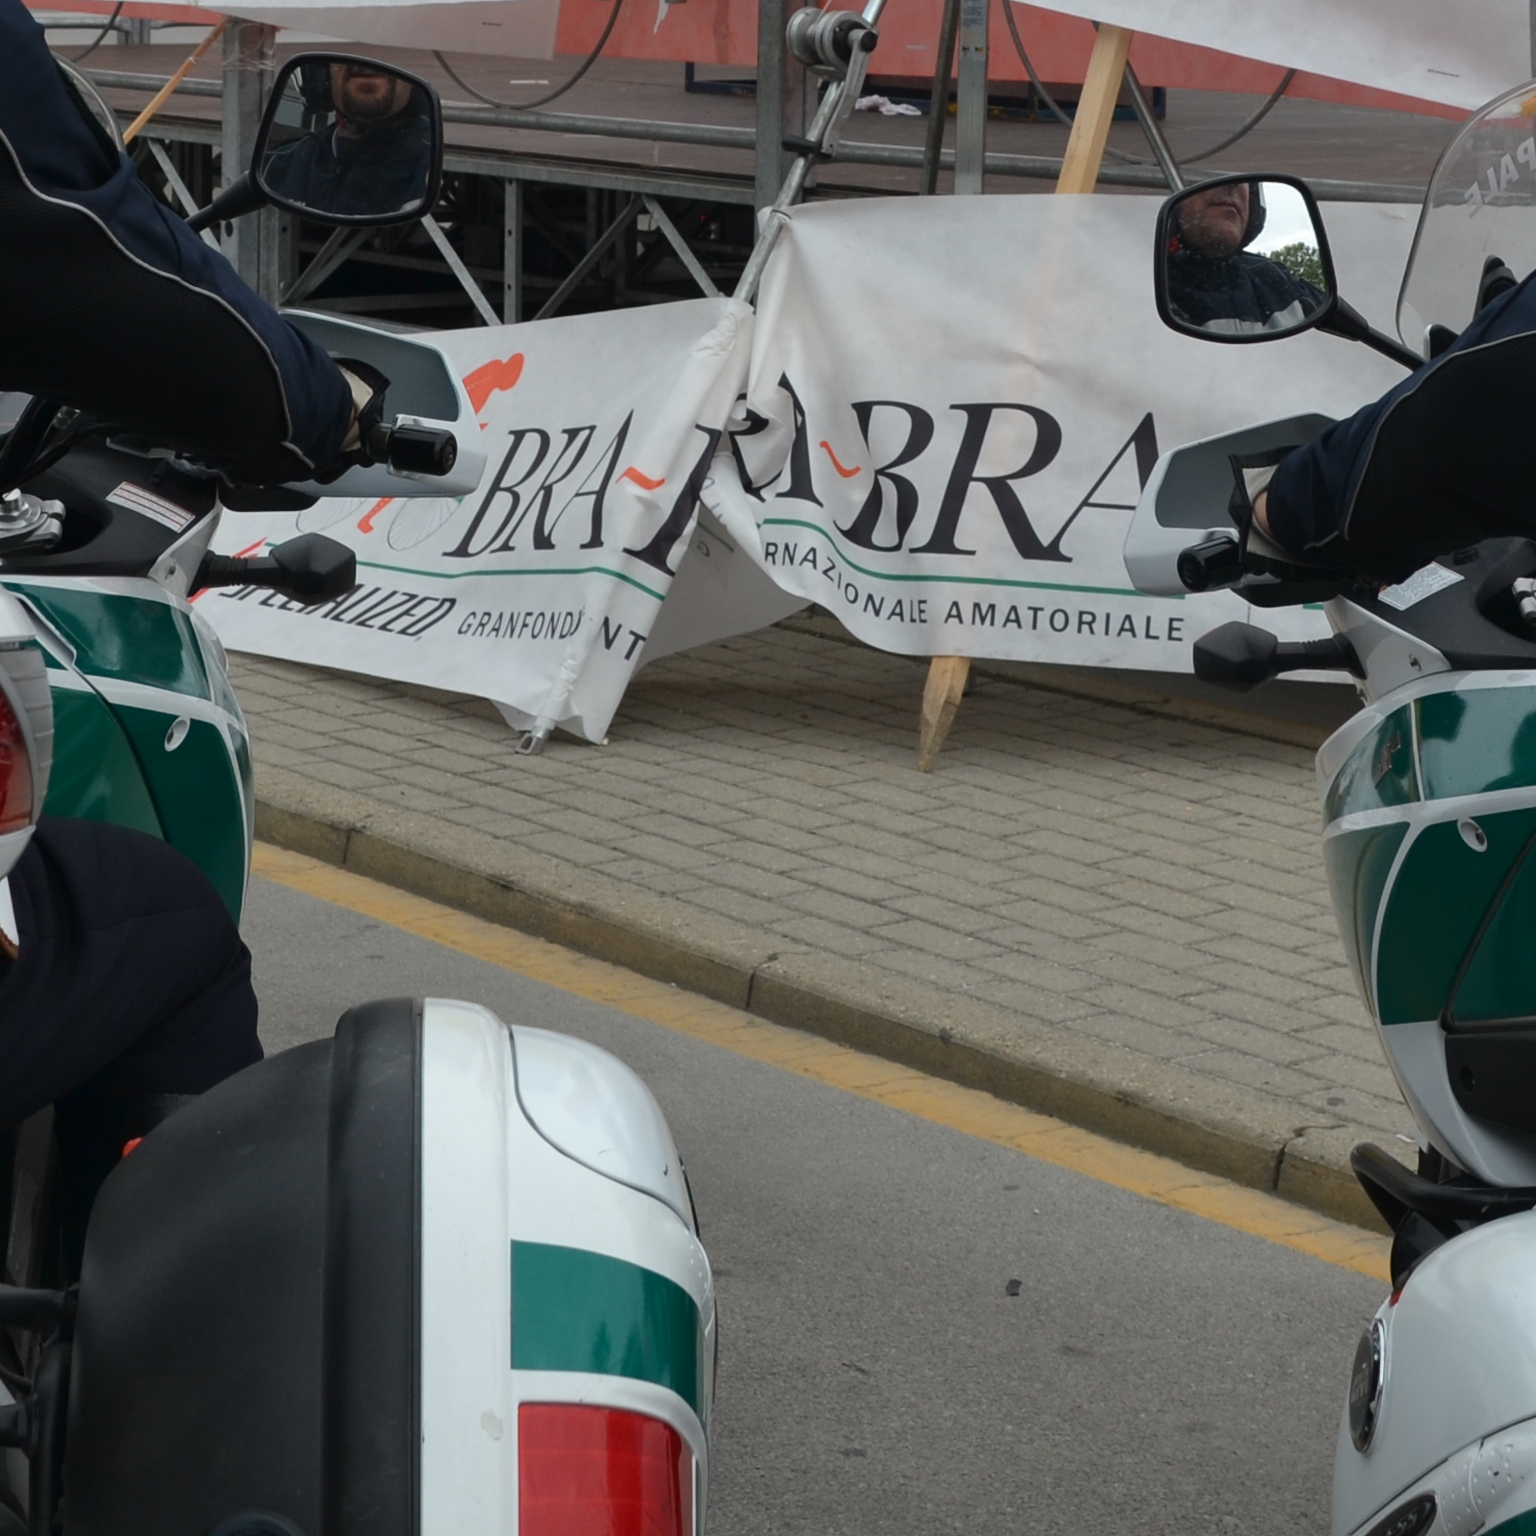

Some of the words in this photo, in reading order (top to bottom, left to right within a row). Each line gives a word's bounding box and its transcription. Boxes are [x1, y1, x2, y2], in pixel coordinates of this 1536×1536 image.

[441, 408, 634, 560] BRA
[833, 398, 1162, 565] BRA
[943, 600, 1187, 644] AMATORIALE
